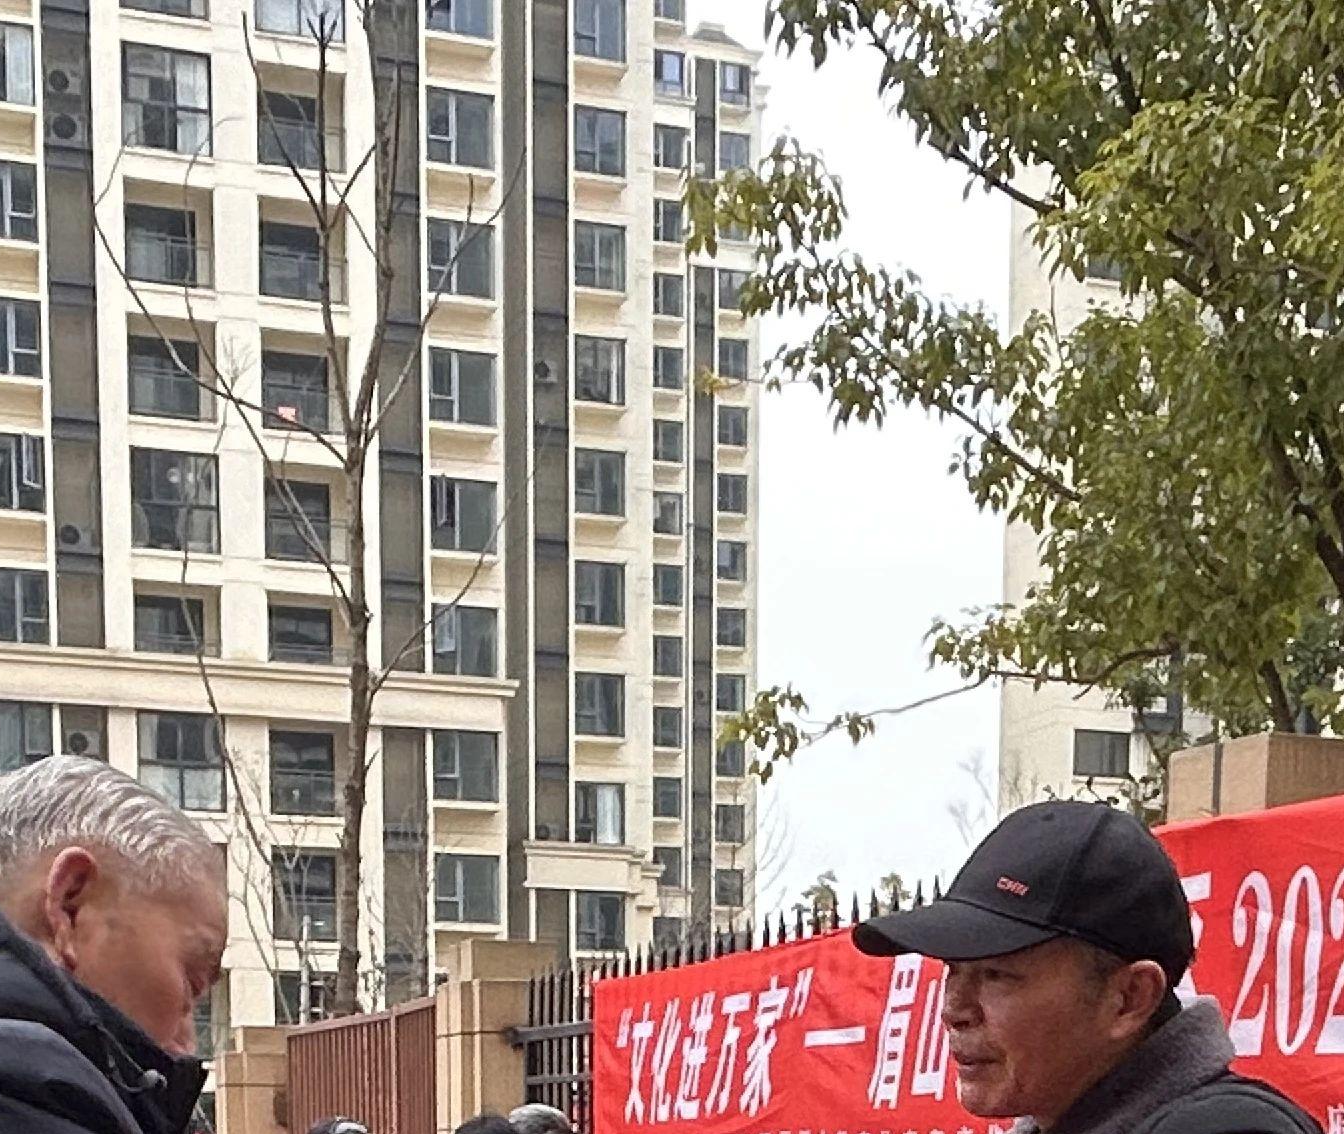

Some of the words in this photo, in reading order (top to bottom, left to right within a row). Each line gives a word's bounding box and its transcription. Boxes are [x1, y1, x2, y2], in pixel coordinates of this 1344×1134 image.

[617, 953, 961, 1124] “文化进万家”—眉山
